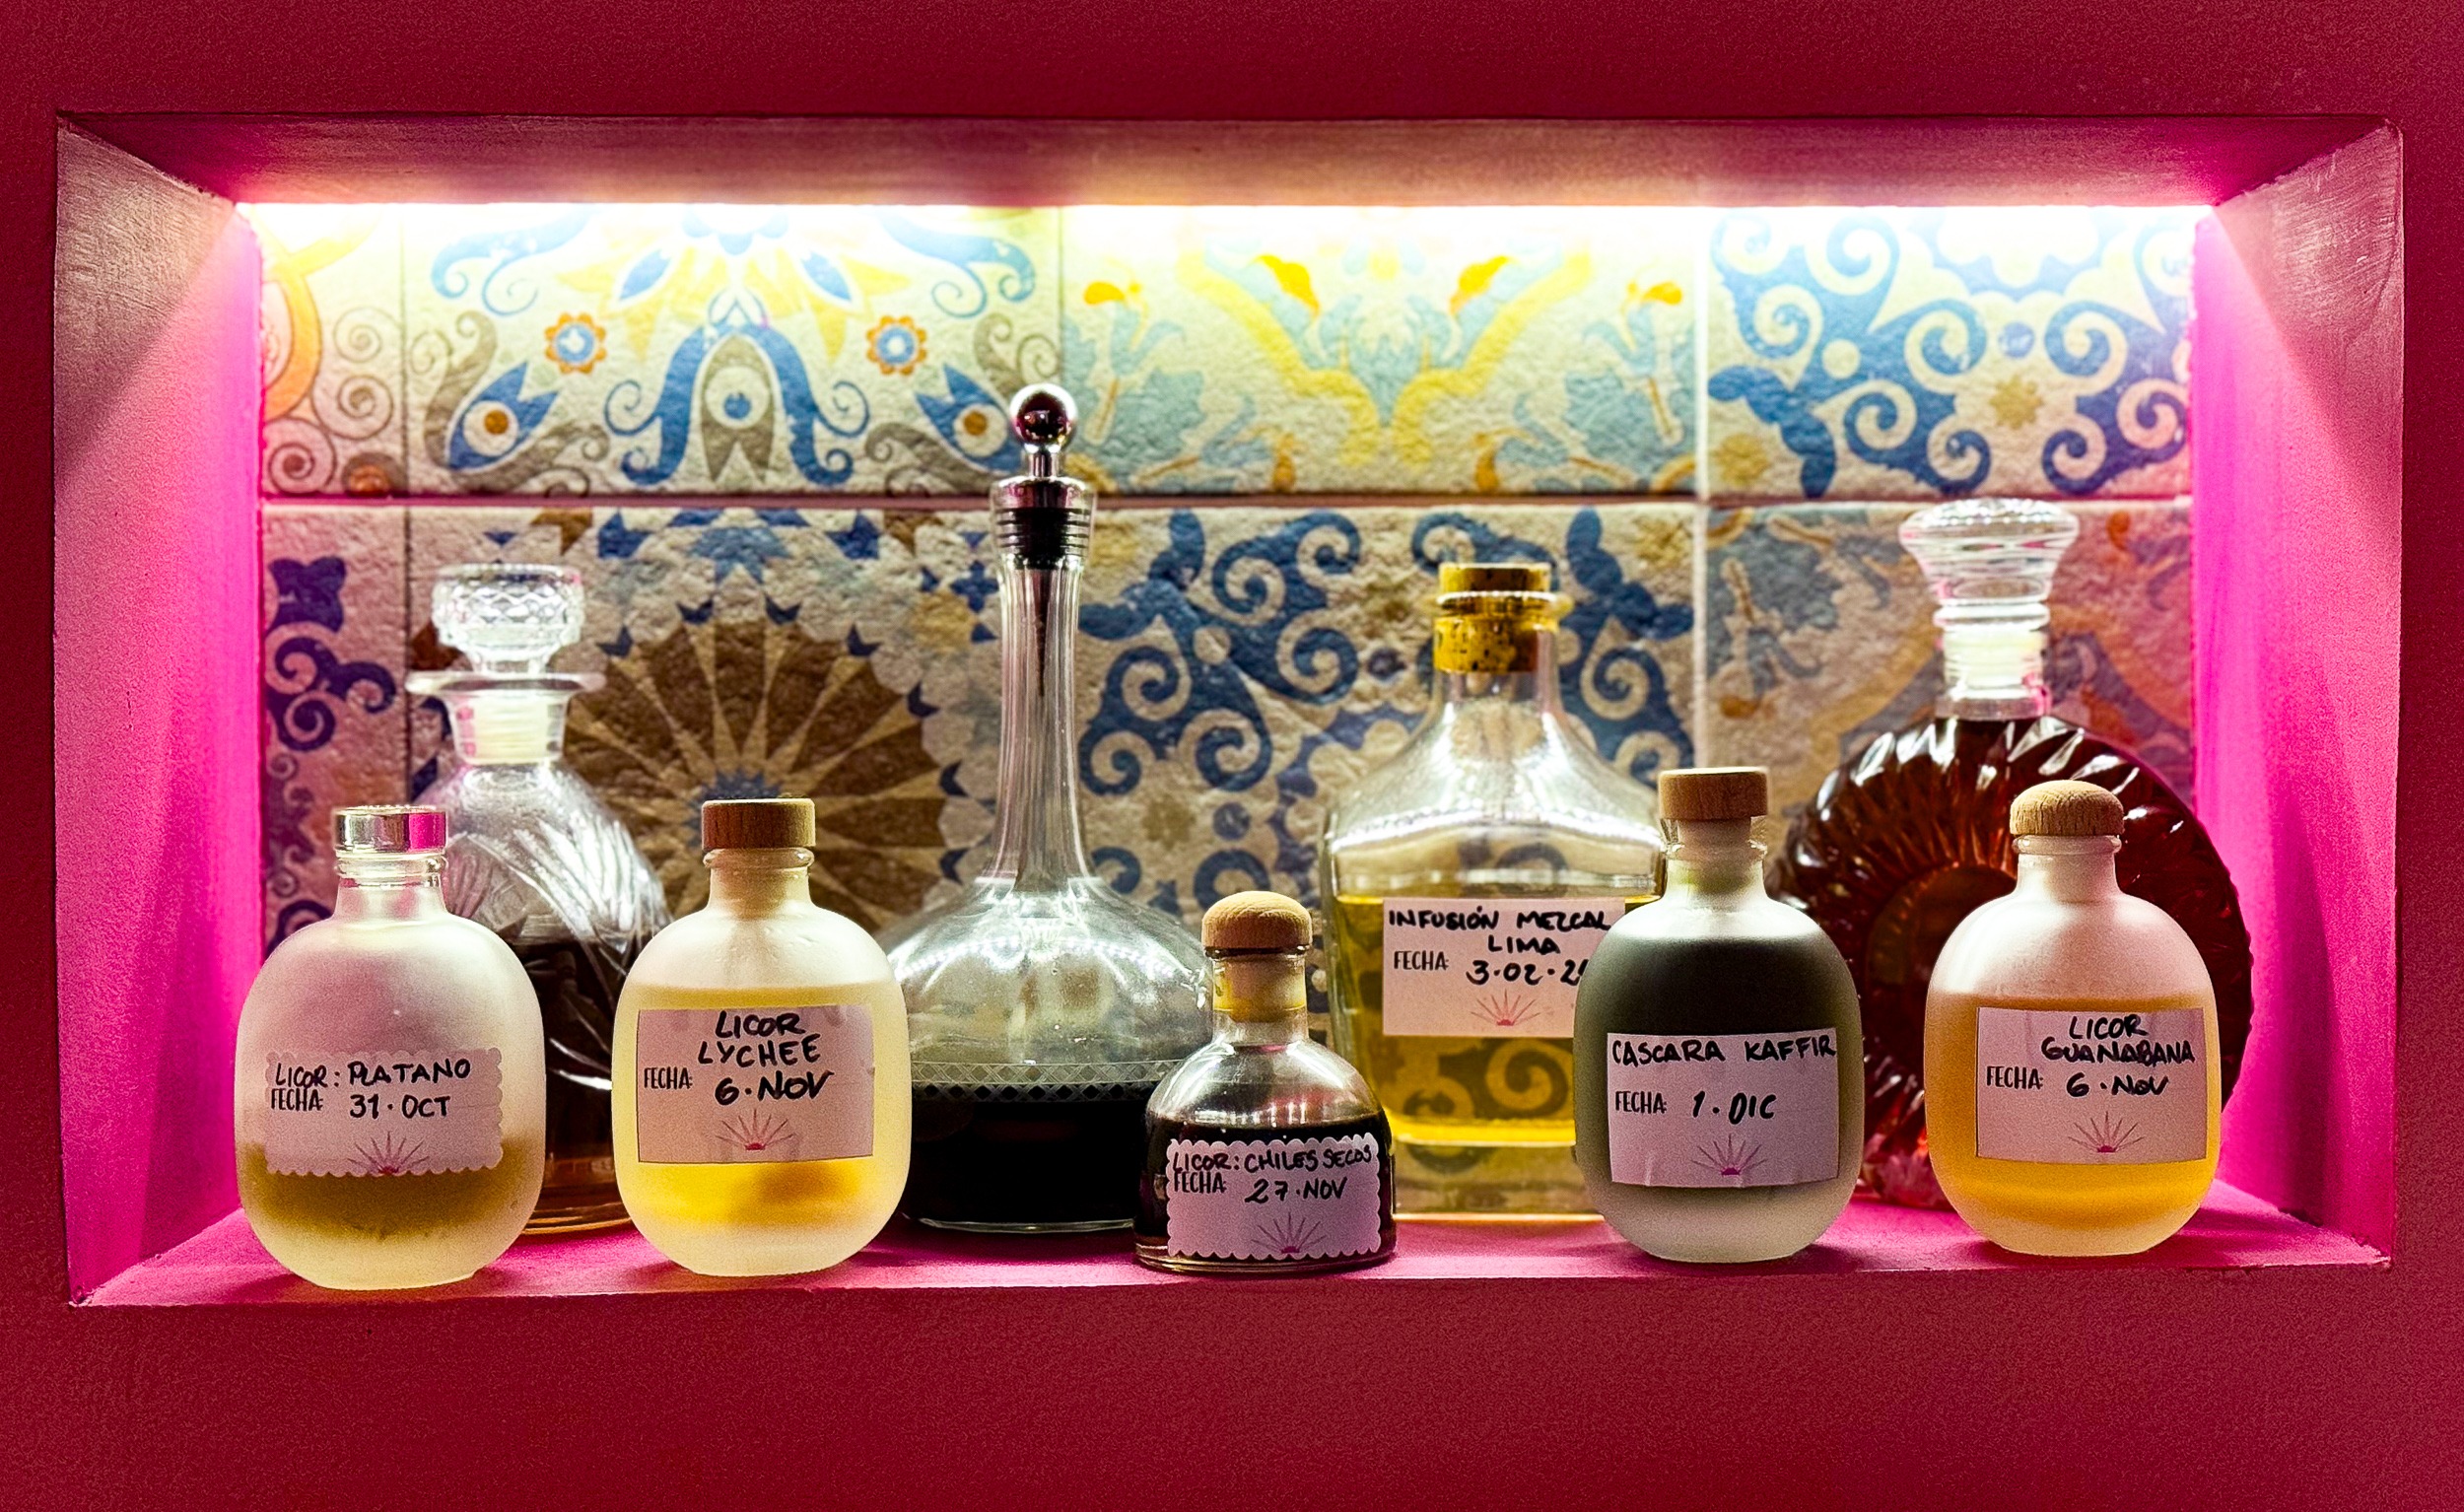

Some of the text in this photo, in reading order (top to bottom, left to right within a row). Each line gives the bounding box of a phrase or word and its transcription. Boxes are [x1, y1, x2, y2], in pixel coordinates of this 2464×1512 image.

[1389, 906, 1611, 932] INFUSIÓN MEZCAL
[1487, 934, 1561, 955] LIMA
[1394, 950, 1449, 971] FECHA:
[715, 1010, 806, 1038] LICOR
[2069, 1014, 2149, 1040] LICOR
[698, 1033, 821, 1067] LYCHEE
[1612, 1035, 1837, 1067] CASCARA KAFFIR
[2040, 1037, 2196, 1067] GUANABANA
[275, 1058, 471, 1088] LICOR: PLATANO
[644, 1065, 693, 1090] FECHA:
[1986, 1065, 2044, 1090] FECHA:
[271, 1087, 323, 1112] FECHA:
[1615, 1090, 1668, 1115] FECHA:
[1173, 1144, 1372, 1173] LICOR: CHILES SECOS
[1174, 1170, 1227, 1194] FECHA:
